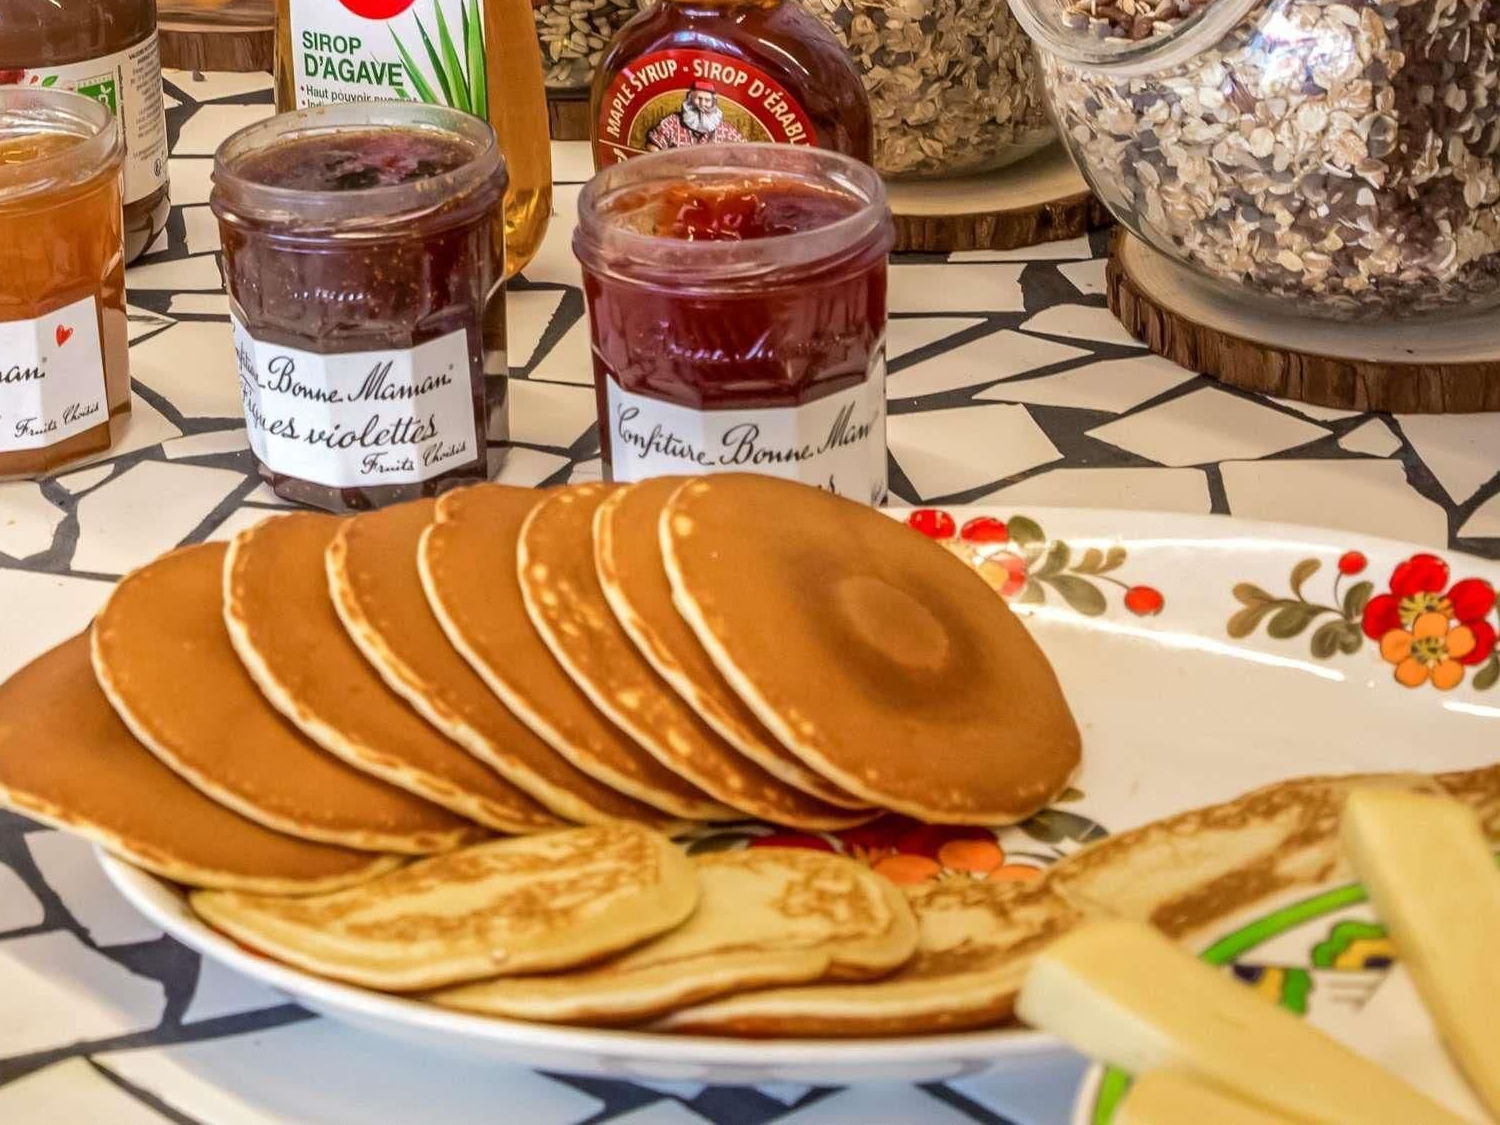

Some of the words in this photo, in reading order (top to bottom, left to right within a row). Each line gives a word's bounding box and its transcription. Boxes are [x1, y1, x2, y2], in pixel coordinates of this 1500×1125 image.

[302, 30, 362, 55] SIROP
[304, 53, 404, 87] D'AGAVE
[306, 84, 329, 99] Haut
[331, 91, 371, 103] pouvoir
[606, 82, 636, 138] MAPLE
[629, 59, 678, 92] SYRUP
[692, 58, 749, 88] SIROP
[747, 79, 810, 146] D'ÉRABL
[268, 356, 344, 403] Bonne
[348, 360, 451, 402] Maman
[14, 417, 58, 438] Fruits
[62, 401, 100, 426] Choisis
[304, 413, 438, 449] violettes
[617, 403, 712, 466] Confiture
[719, 422, 814, 465] Bonne
[360, 451, 415, 474] Fruits
[422, 441, 466, 468] Choisis
